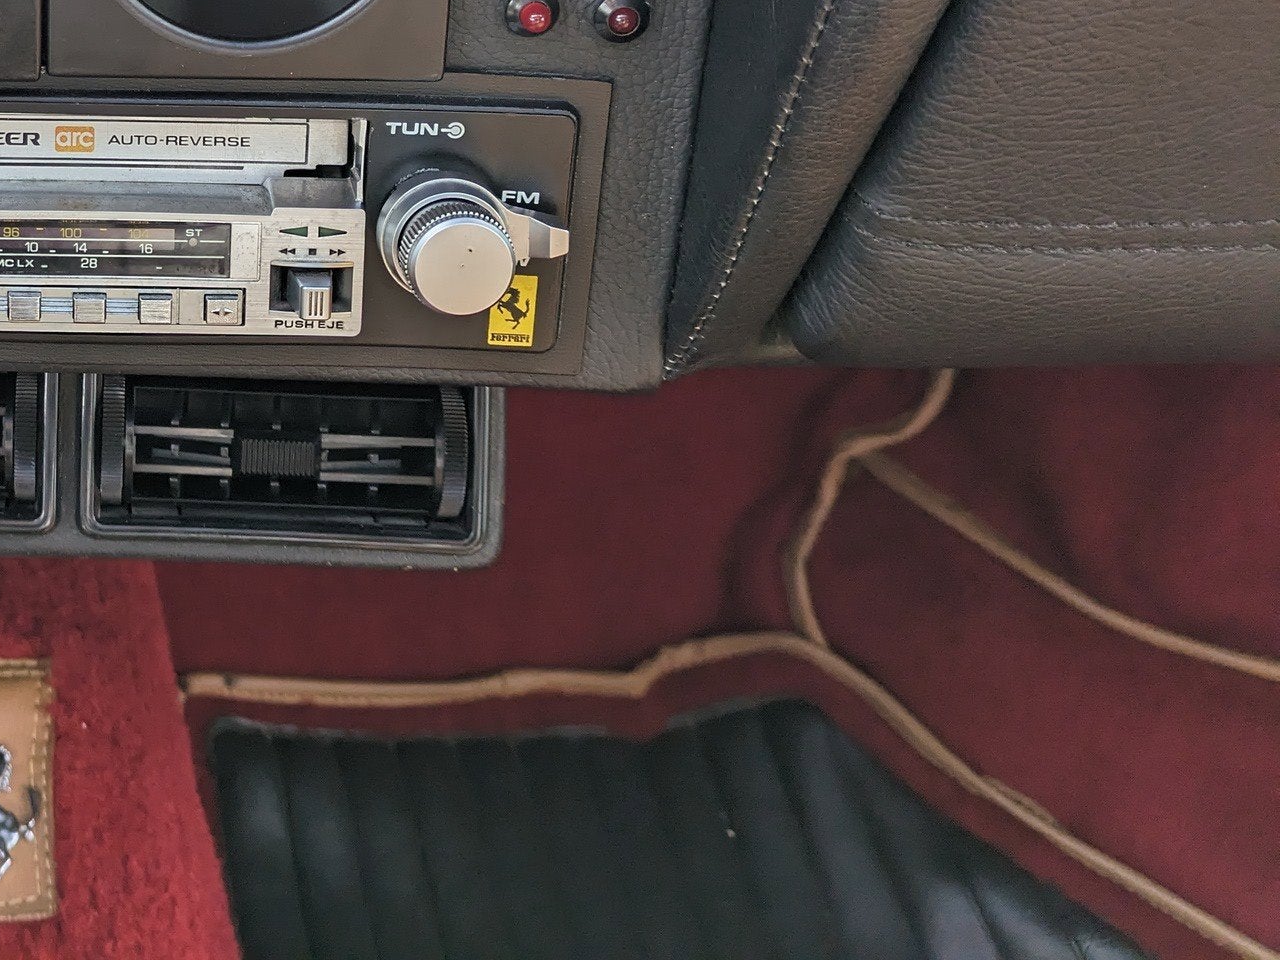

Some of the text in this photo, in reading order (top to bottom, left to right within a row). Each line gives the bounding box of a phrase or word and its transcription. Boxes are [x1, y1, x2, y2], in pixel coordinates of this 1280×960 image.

[386, 122, 438, 136] TUN
[56, 130, 94, 149] arc
[108, 134, 251, 148] AUTO-REVERSE
[501, 190, 540, 205] FM
[3, 227, 20, 237] 96
[59, 228, 82, 238] 100
[185, 229, 203, 237] ST
[24, 242, 39, 252] 10
[73, 243, 87, 253] 14
[138, 244, 153, 254] 16
[80, 258, 98, 269] 28
[274, 320, 344, 330] PUSH EJE
[490, 332, 530, 343] Ferrari
